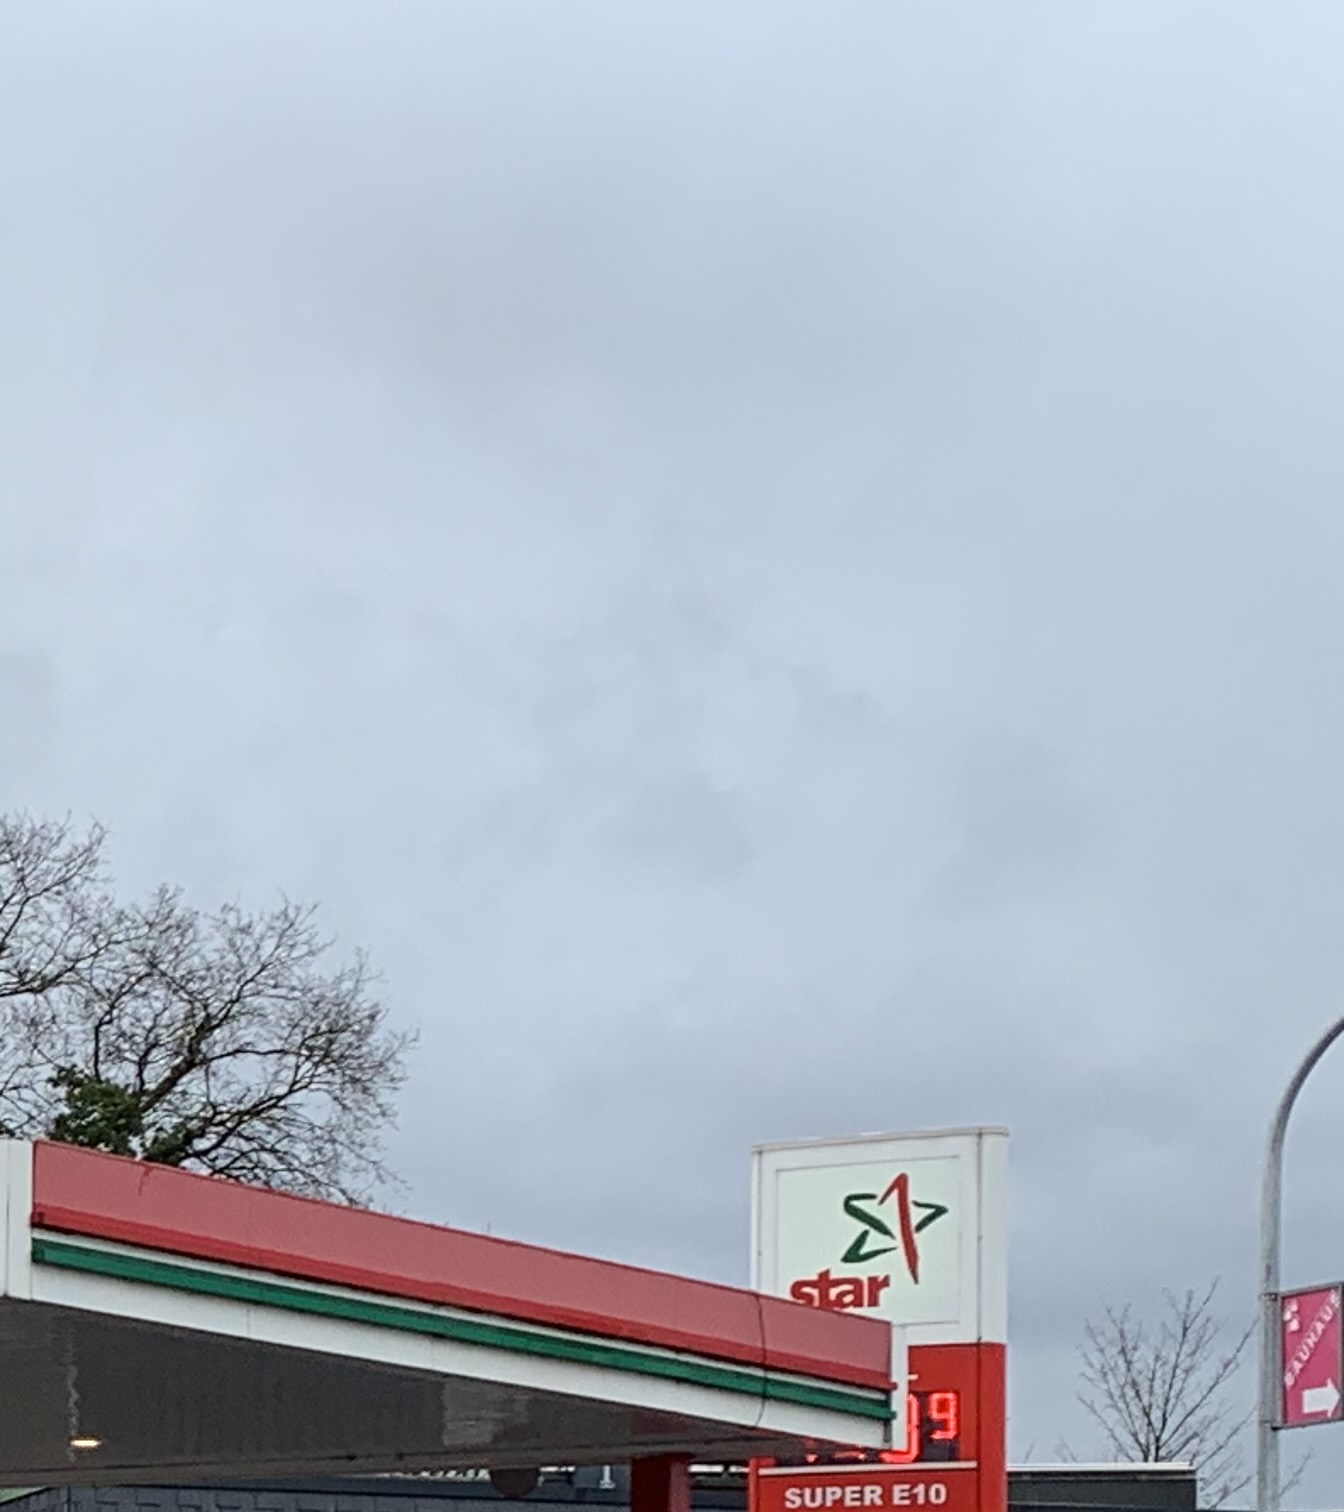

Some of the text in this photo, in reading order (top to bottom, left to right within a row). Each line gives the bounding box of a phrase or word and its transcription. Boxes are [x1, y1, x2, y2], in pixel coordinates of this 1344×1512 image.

[789, 1269, 891, 1309] star
[784, 1482, 947, 1509] SUPER E10
